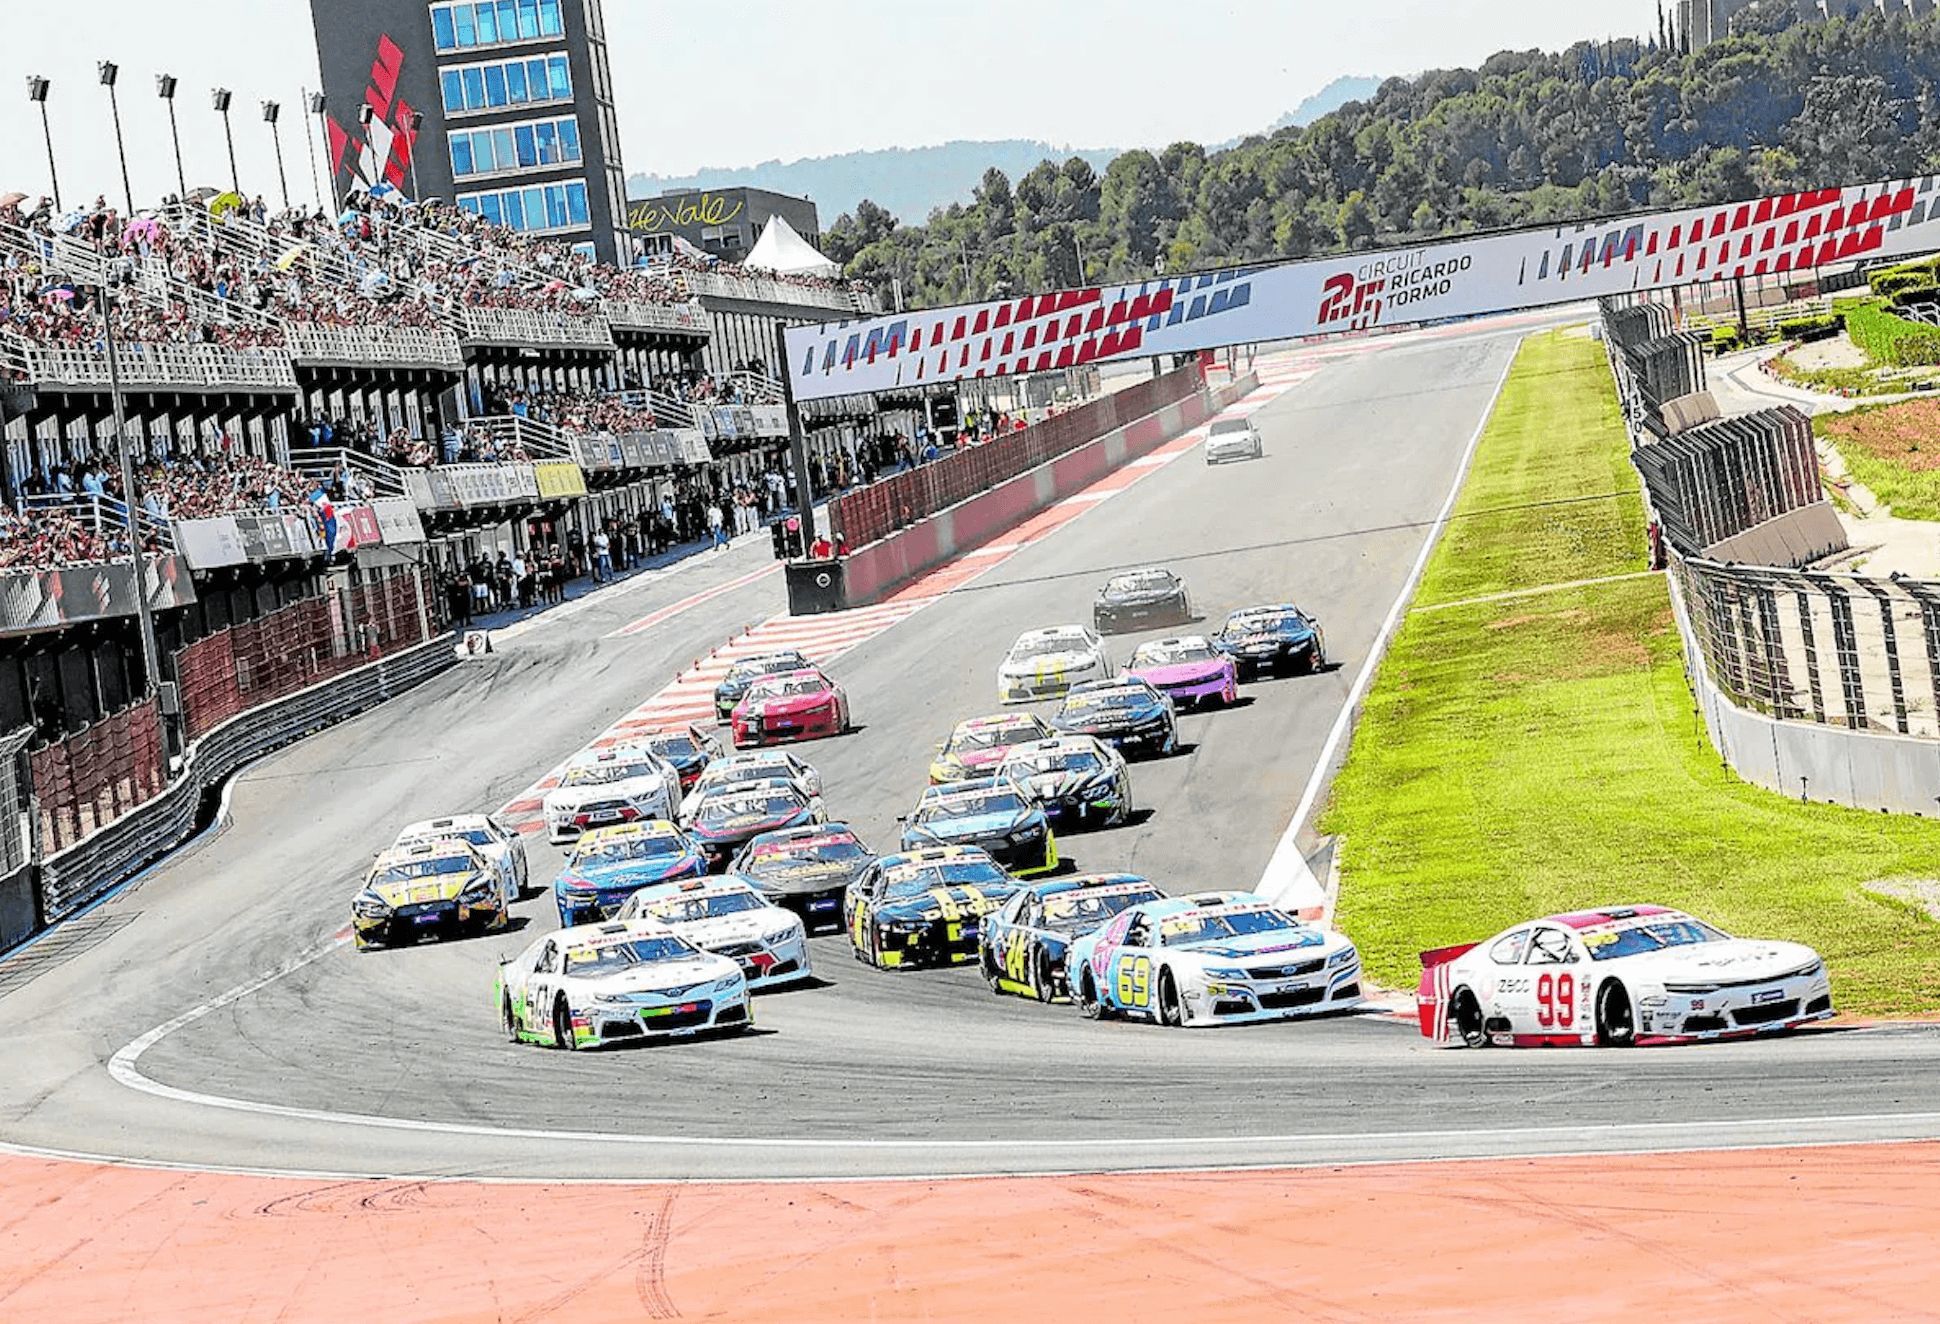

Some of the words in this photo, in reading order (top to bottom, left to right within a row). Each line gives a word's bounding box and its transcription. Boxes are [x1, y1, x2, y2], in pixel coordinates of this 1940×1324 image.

[1358, 250, 1426, 281] CIRCUIT
[1391, 255, 1472, 290] RICARDO
[1386, 279, 1451, 309] TORMO
[1006, 927, 1026, 982] 24
[1117, 954, 1151, 1008] 69
[1536, 972, 1574, 1029] 99
